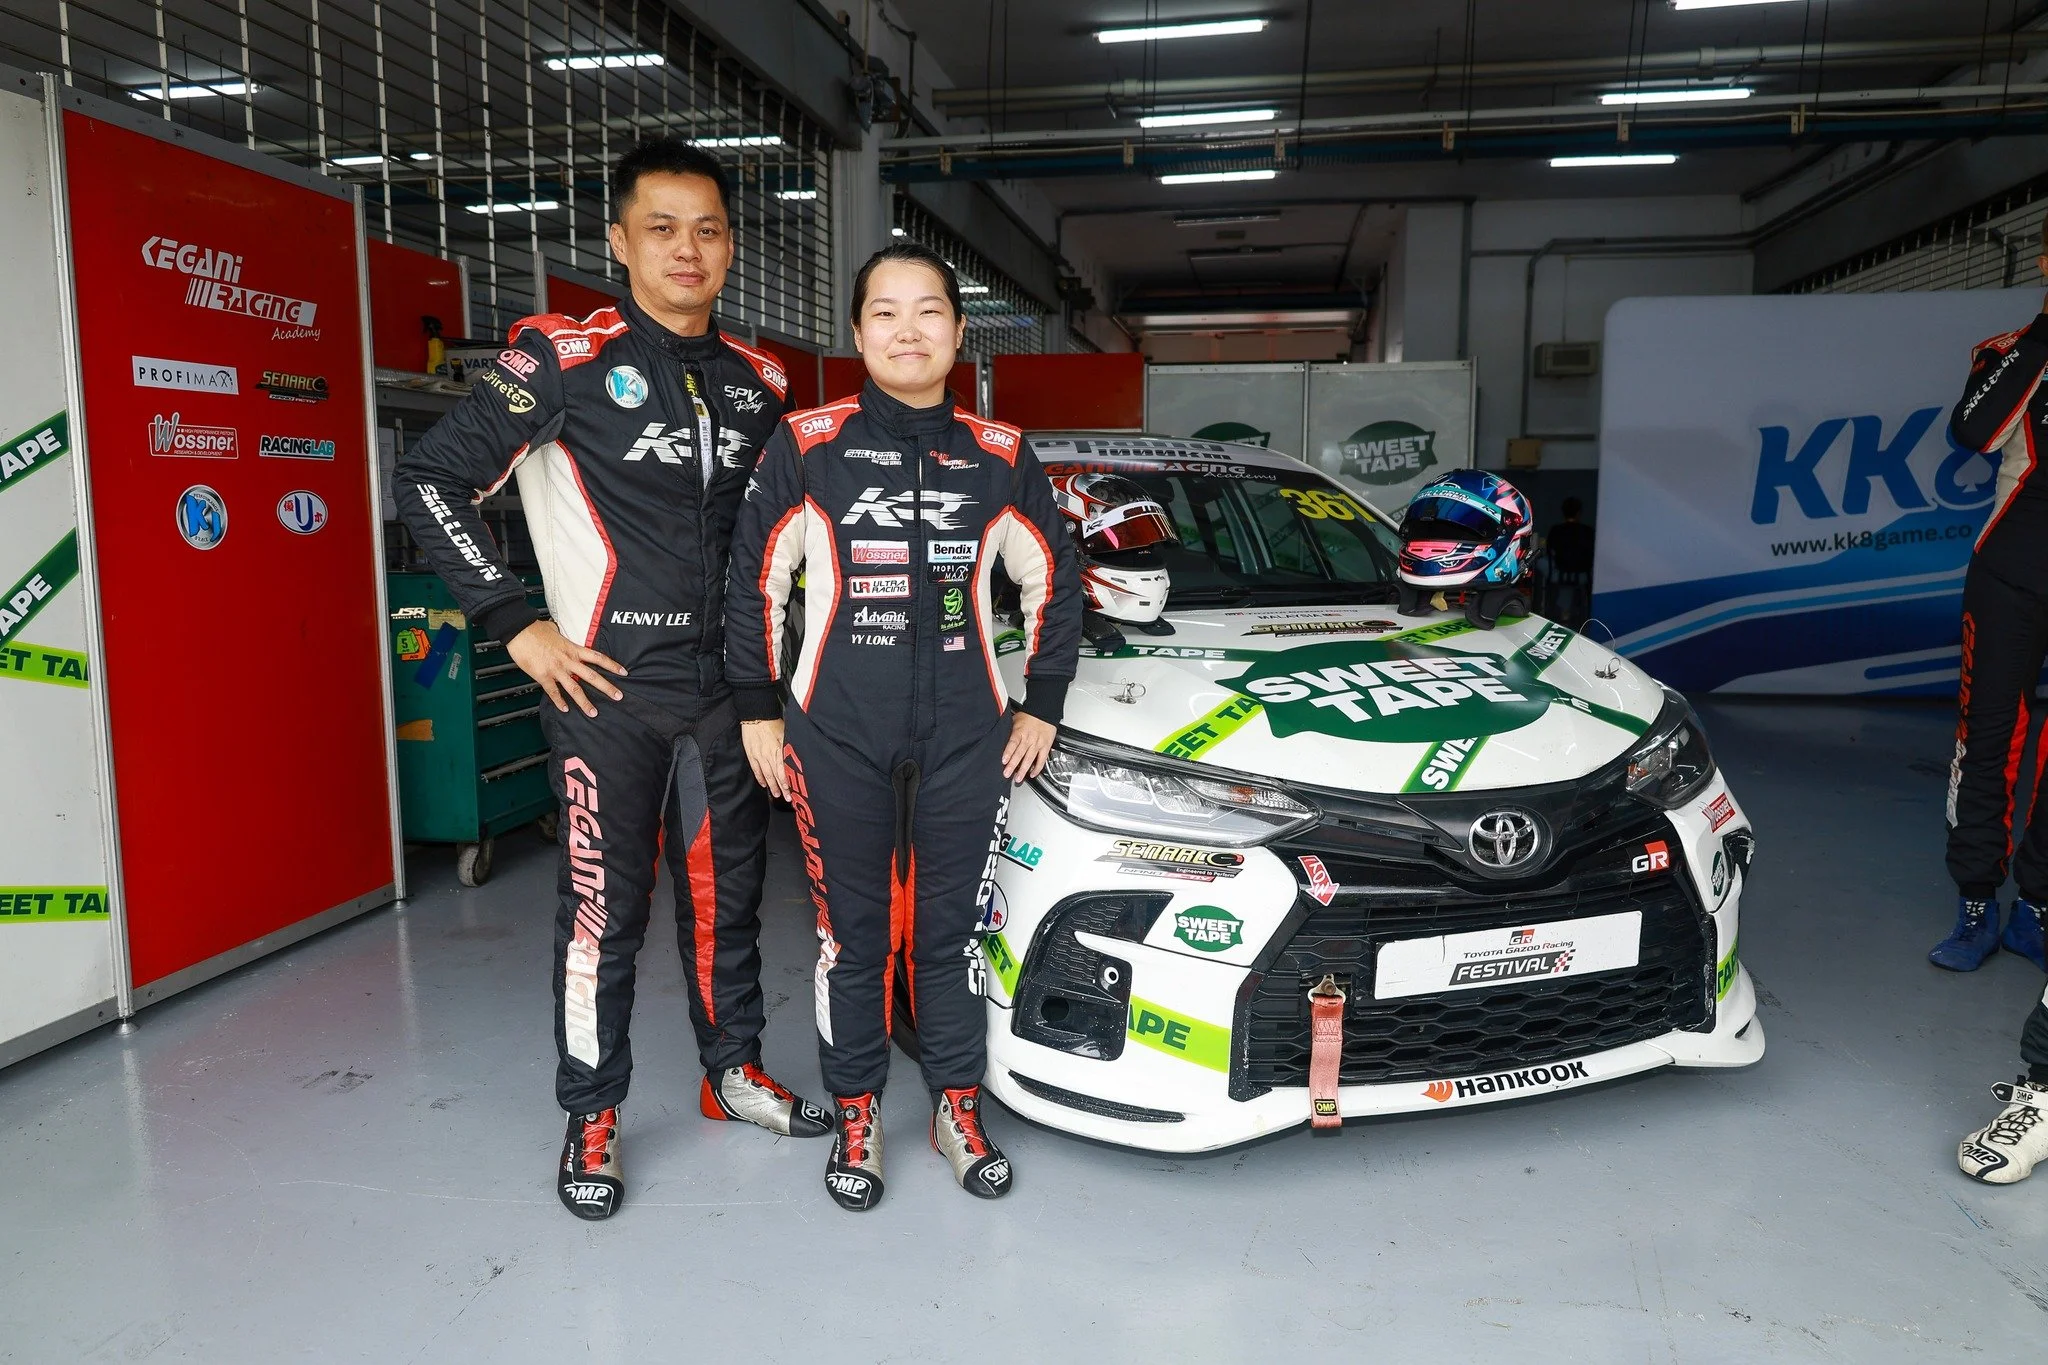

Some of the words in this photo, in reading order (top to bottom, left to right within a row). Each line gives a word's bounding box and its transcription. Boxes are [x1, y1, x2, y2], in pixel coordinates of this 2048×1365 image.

[271, 327, 321, 341] Academy
[557, 340, 591, 355] OMP
[499, 350, 536, 375] OMP
[139, 366, 230, 388] PROFIMAX
[762, 367, 788, 389] OMP
[724, 384, 763, 402] SPV
[800, 417, 834, 434] OMP
[260, 435, 335, 456] RACINGLAB
[981, 430, 1014, 448] OMP
[1343, 434, 1430, 460] SWEET
[0, 427, 62, 483] APE
[1356, 452, 1421, 474] TAPE
[1750, 405, 2003, 526] KK8
[1203, 471, 1277, 481] Academy
[1279, 488, 1377, 523] 361
[1770, 523, 1973, 557] www.kk8game.co
[933, 543, 973, 556] Bendix
[871, 585, 908, 594] RACING
[872, 579, 906, 588] ULTRA
[0, 573, 53, 640] APE
[610, 610, 663, 626] KENNY
[666, 611, 692, 626] LEE
[866, 634, 898, 646] LOKE
[1528, 631, 1567, 660] SWEET
[1133, 646, 1226, 659] TAPE
[1245, 656, 1508, 704] SWEET
[1313, 676, 1529, 723] TAPE
[1632, 847, 1669, 874] GR
[1176, 867, 1207, 876] Engineered
[1177, 915, 1241, 933] SWEET
[1185, 928, 1232, 945] TAPE
[1510, 933, 1534, 945] GR
[1464, 949, 1503, 959] TOYOTA
[1505, 944, 1541, 954] GAZOO
[1542, 940, 1575, 950] Racing
[1456, 956, 1550, 981] FESTIVAL
[2015, 1089, 2034, 1103] OMP
[1316, 1101, 1336, 1113] OMP
